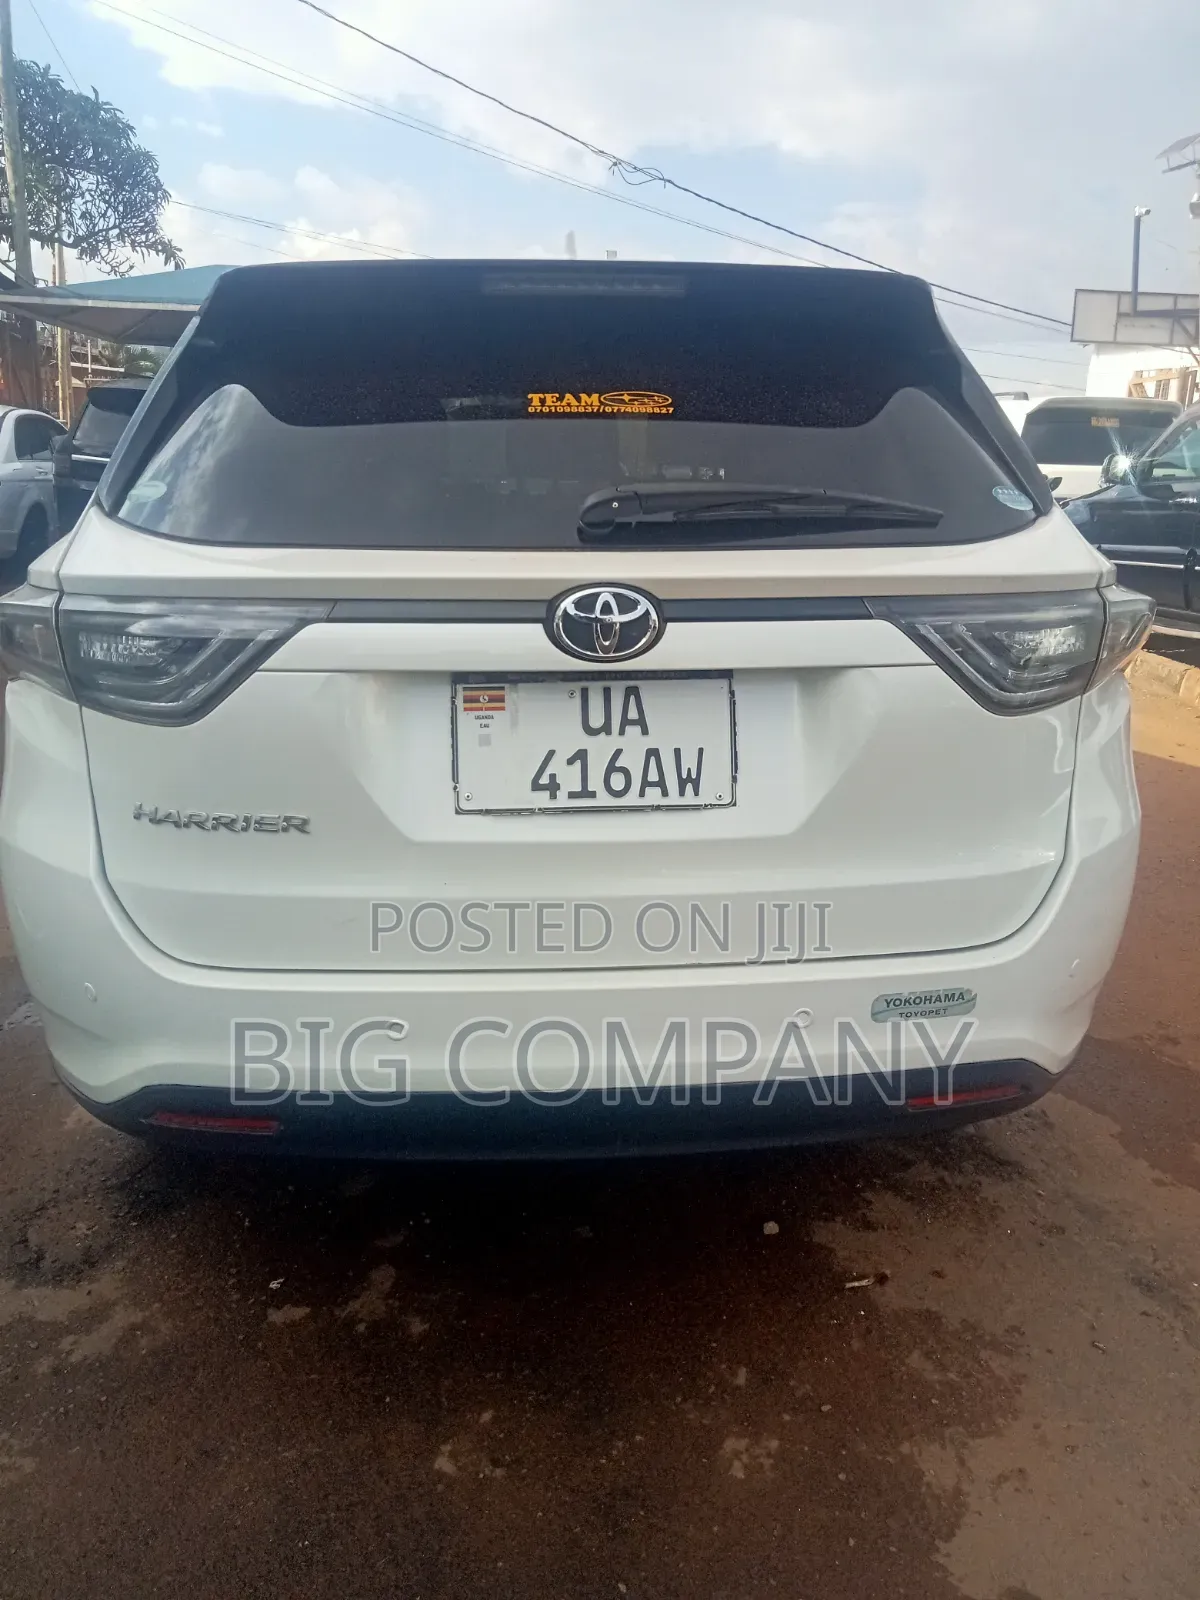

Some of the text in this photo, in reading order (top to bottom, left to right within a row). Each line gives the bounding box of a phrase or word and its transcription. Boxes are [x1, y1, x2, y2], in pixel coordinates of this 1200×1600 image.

[527, 393, 600, 406] TEAM
[580, 685, 650, 737] UA
[530, 746, 705, 800] 416AW
[132, 801, 311, 834] HARRIER
[884, 991, 966, 1008] YOKOHAMA
[898, 1008, 949, 1019] TOYOPET
